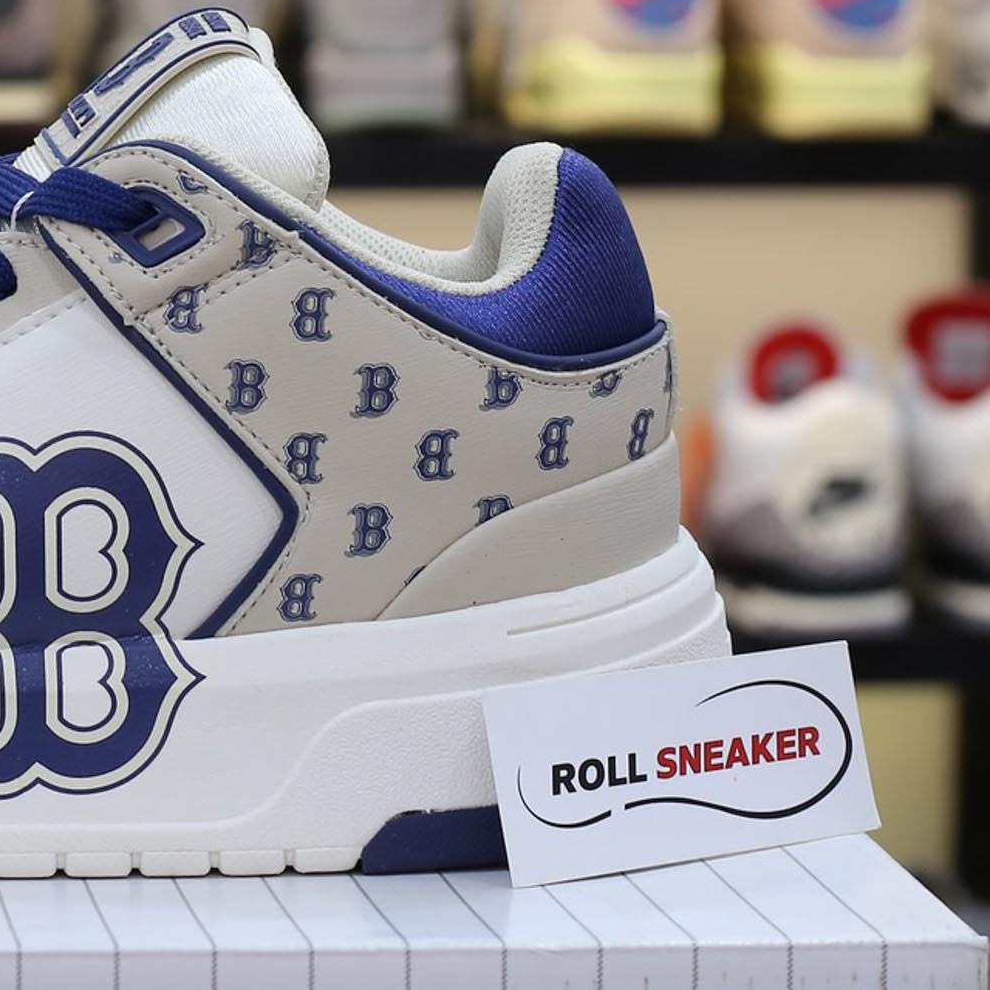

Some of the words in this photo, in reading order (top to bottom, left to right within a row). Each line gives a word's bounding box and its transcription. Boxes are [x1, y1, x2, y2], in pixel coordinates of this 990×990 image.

[289, 287, 336, 342] B
[225, 359, 270, 414] B
[350, 362, 402, 418] B
[282, 431, 328, 484] B
[412, 428, 460, 482] B
[534, 416, 574, 470] B
[344, 503, 394, 557] B
[276, 573, 323, 622] B
[551, 753, 648, 795] ROLL
[656, 726, 821, 779] SNEAKER
